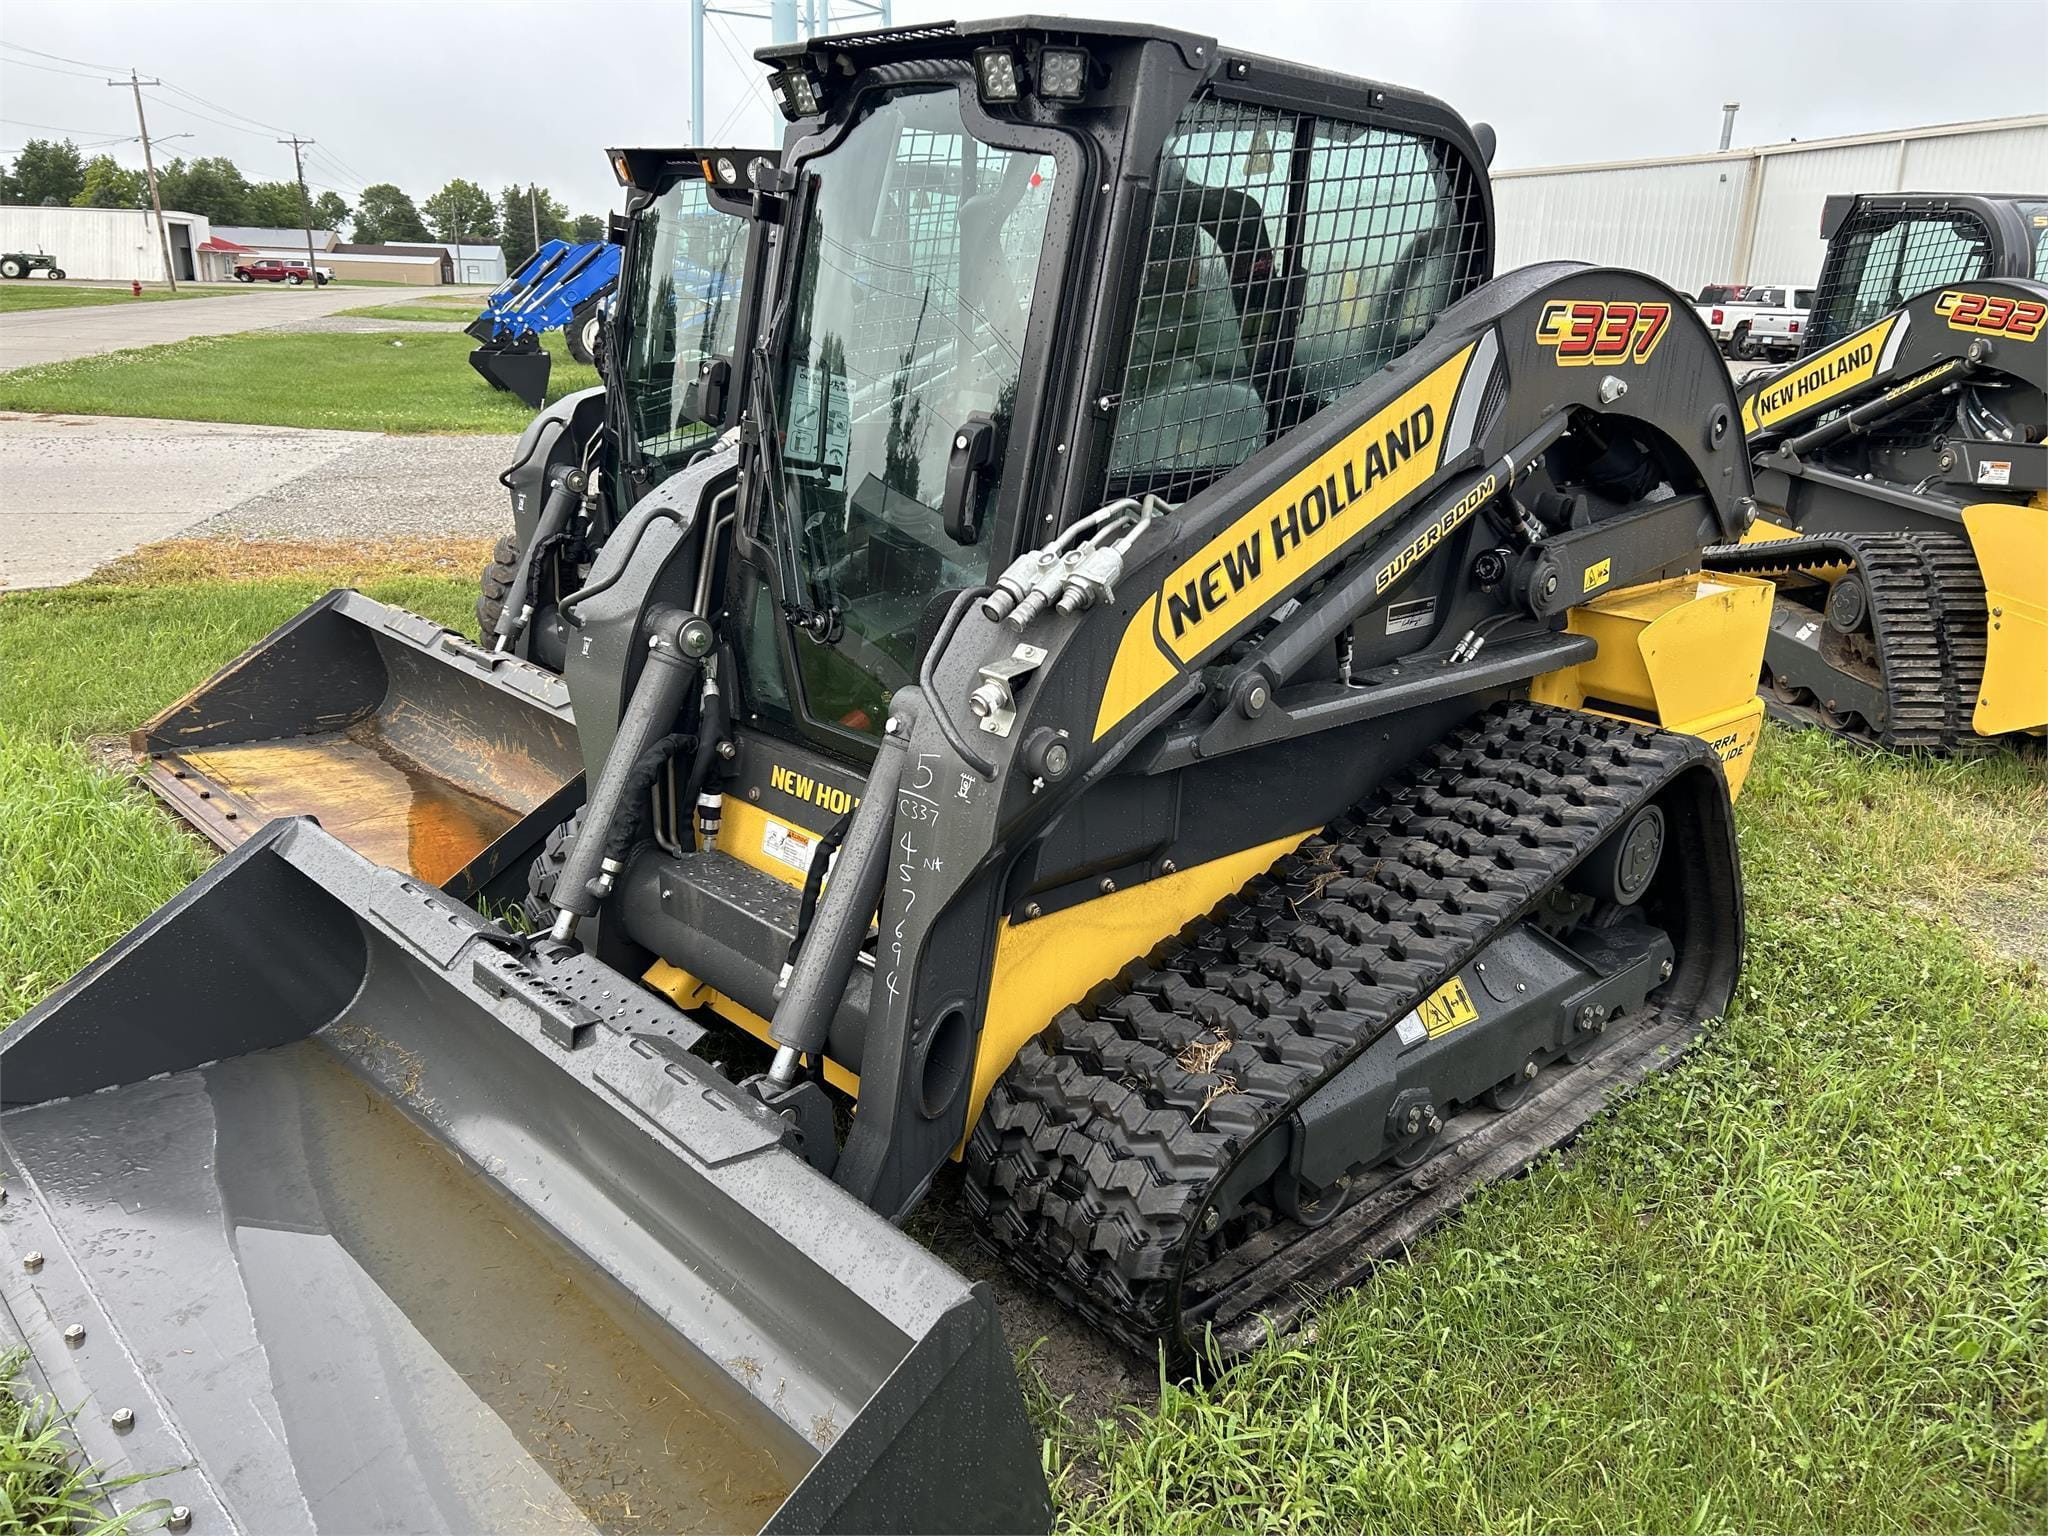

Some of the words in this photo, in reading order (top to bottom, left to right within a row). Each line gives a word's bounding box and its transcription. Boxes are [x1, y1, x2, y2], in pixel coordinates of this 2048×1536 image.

[1537, 302, 1671, 366] C337
[1935, 292, 2047, 340] C232
[1761, 383, 1794, 416] NEW
[1798, 342, 1873, 398] HOLLAND
[1167, 529, 1261, 640] NEW
[1270, 403, 1434, 562] HOLLAND
[1376, 523, 1441, 594] SUPER
[1441, 474, 1495, 537] BOOM
[771, 764, 815, 802] NEW
[912, 752, 942, 790] 5
[900, 799, 940, 828] C337
